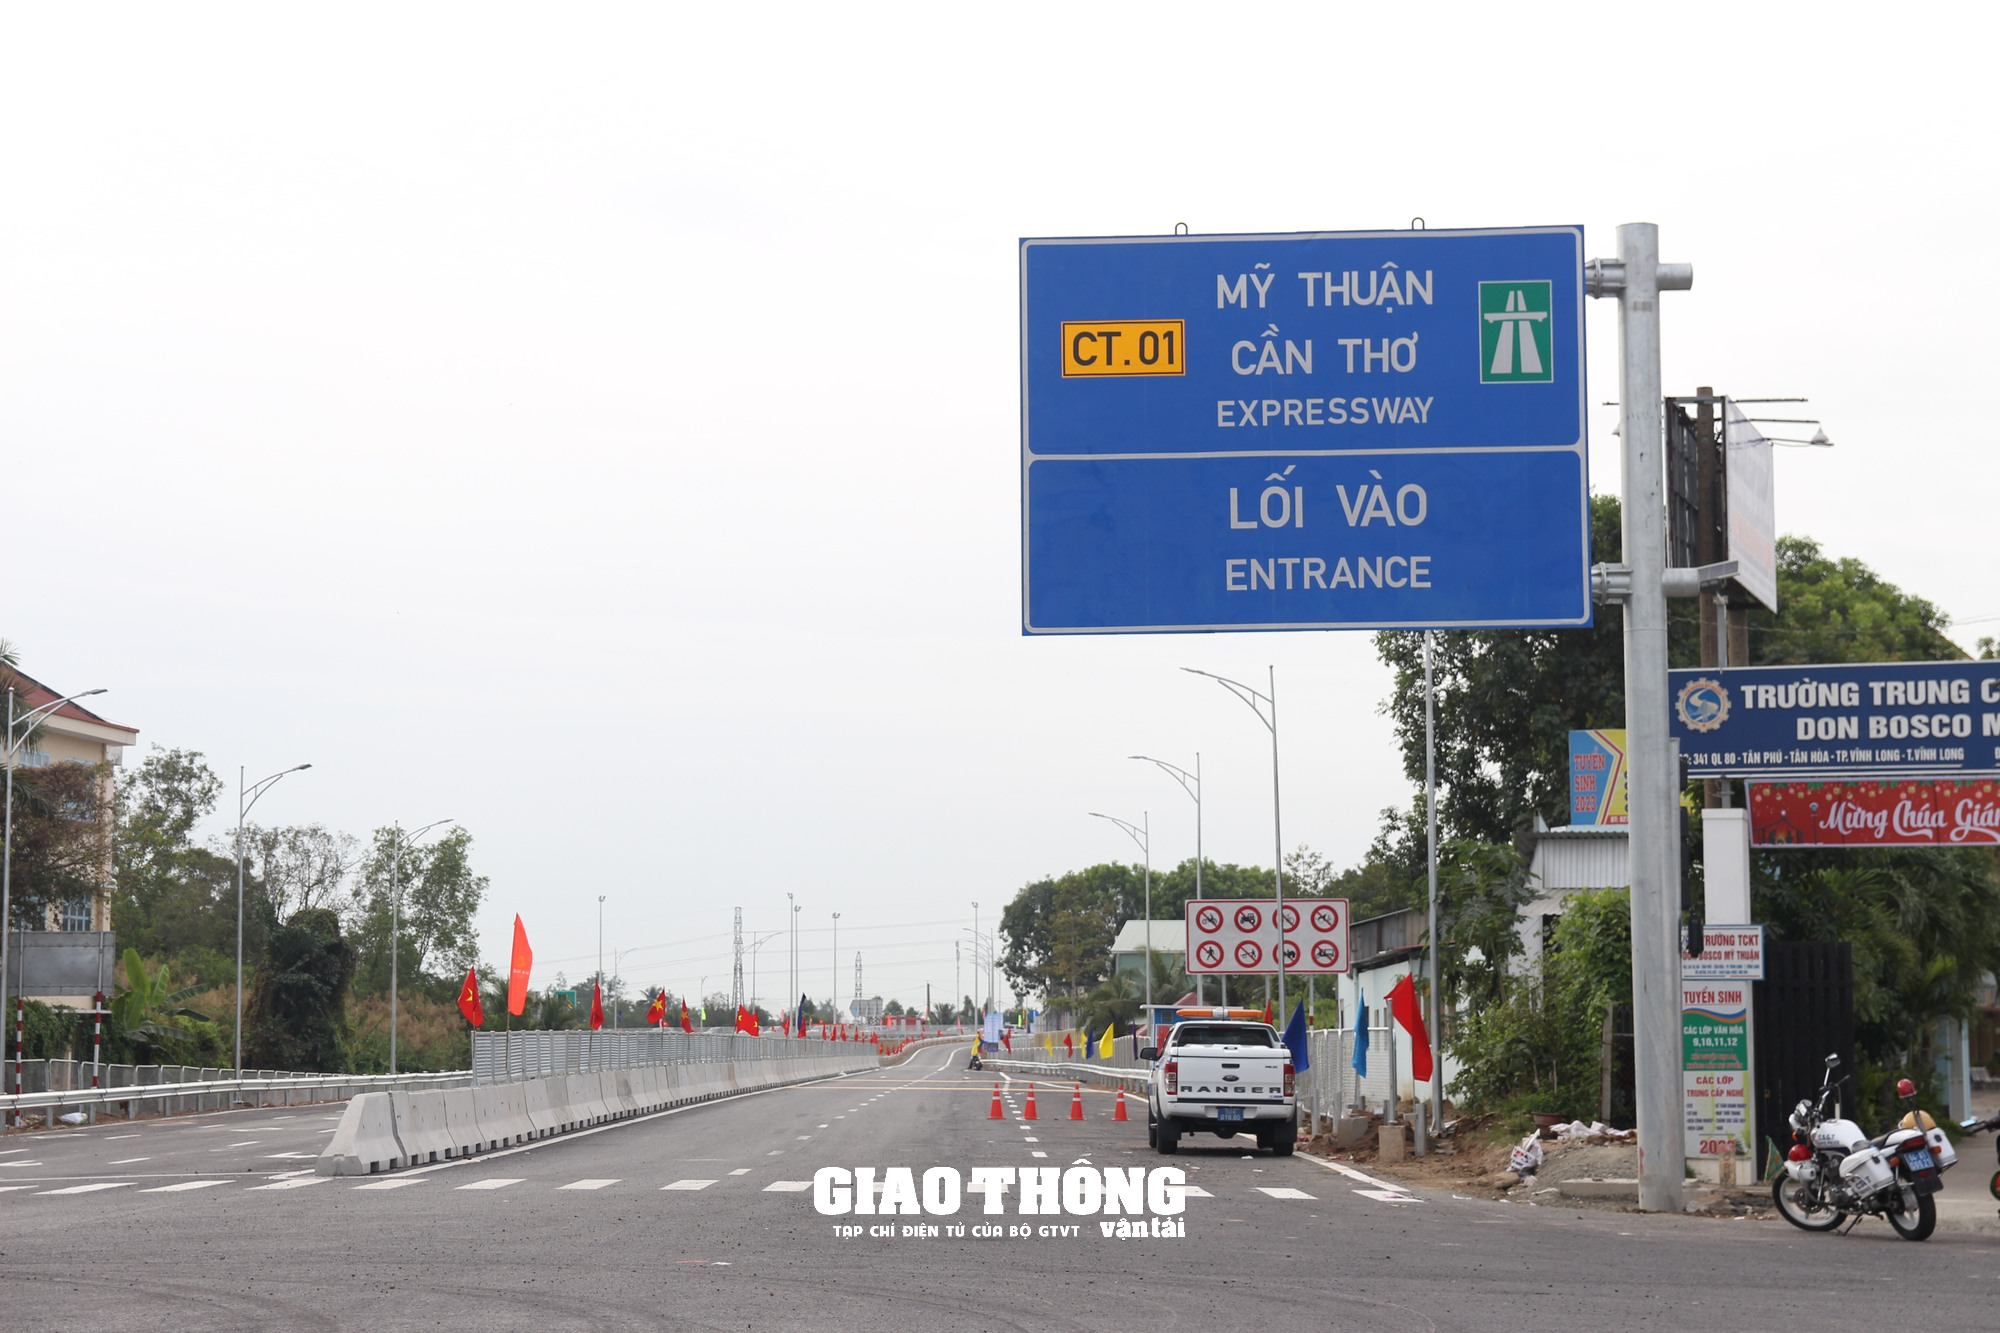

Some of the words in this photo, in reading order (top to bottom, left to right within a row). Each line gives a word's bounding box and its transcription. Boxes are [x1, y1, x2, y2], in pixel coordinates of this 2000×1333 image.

[1217, 263, 1275, 309] MỸ
[1298, 261, 1433, 313] THUẬN
[1072, 330, 1176, 366] CT.01
[1231, 324, 1313, 375] CẦN
[1338, 331, 1418, 373] THƠ
[1217, 396, 1434, 427] EXPRESSWAY
[1229, 465, 1304, 529] LỐI
[1336, 470, 1427, 527] VÀO
[1226, 556, 1432, 591] ENTRANCE
[1741, 678, 1859, 709] TRƯỜNG
[1869, 679, 1970, 706] TRUNG
[1797, 715, 1859, 741] DON
[1869, 713, 1972, 739] BOSCO
[1574, 745, 1605, 770] TUYỂN
[1693, 753, 1708, 765] 341
[1711, 752, 1722, 766] QL
[1724, 752, 1736, 764] 80
[1742, 749, 1761, 764] TÂN
[1763, 748, 1782, 764] PHÚ
[1790, 748, 1808, 763] TÂN
[1811, 748, 1829, 763] HÒA
[1875, 748, 1900, 762] LONG
[1939, 747, 1964, 760] LONG
[1574, 774, 1596, 791] SINH
[1574, 796, 1596, 812] 2023
[1819, 800, 1888, 838] Mừng
[1893, 800, 1947, 840] Chúa
[1703, 932, 1735, 946] RƯỜNG
[1738, 934, 1759, 946] TCKT
[1724, 948, 1734, 960] MỸ
[1737, 948, 1760, 962] THUẬN
[1684, 986, 1715, 1004] TUYỂN
[1718, 991, 1742, 1004] SINH
[1683, 1025, 1697, 1035] CÁC
[1699, 1025, 1712, 1035] LỚP
[1713, 1025, 1728, 1035] VĂN
[1729, 1025, 1743, 1035] HÓA
[1180, 1086, 1281, 1094] RANGER
[1696, 1076, 1714, 1085] CÁC
[1717, 1075, 1734, 1085] LỚP
[1687, 1089, 1709, 1097] TRUNG
[1711, 1087, 1724, 1097] CẤP
[1727, 1088, 1745, 1097] NGHỀ
